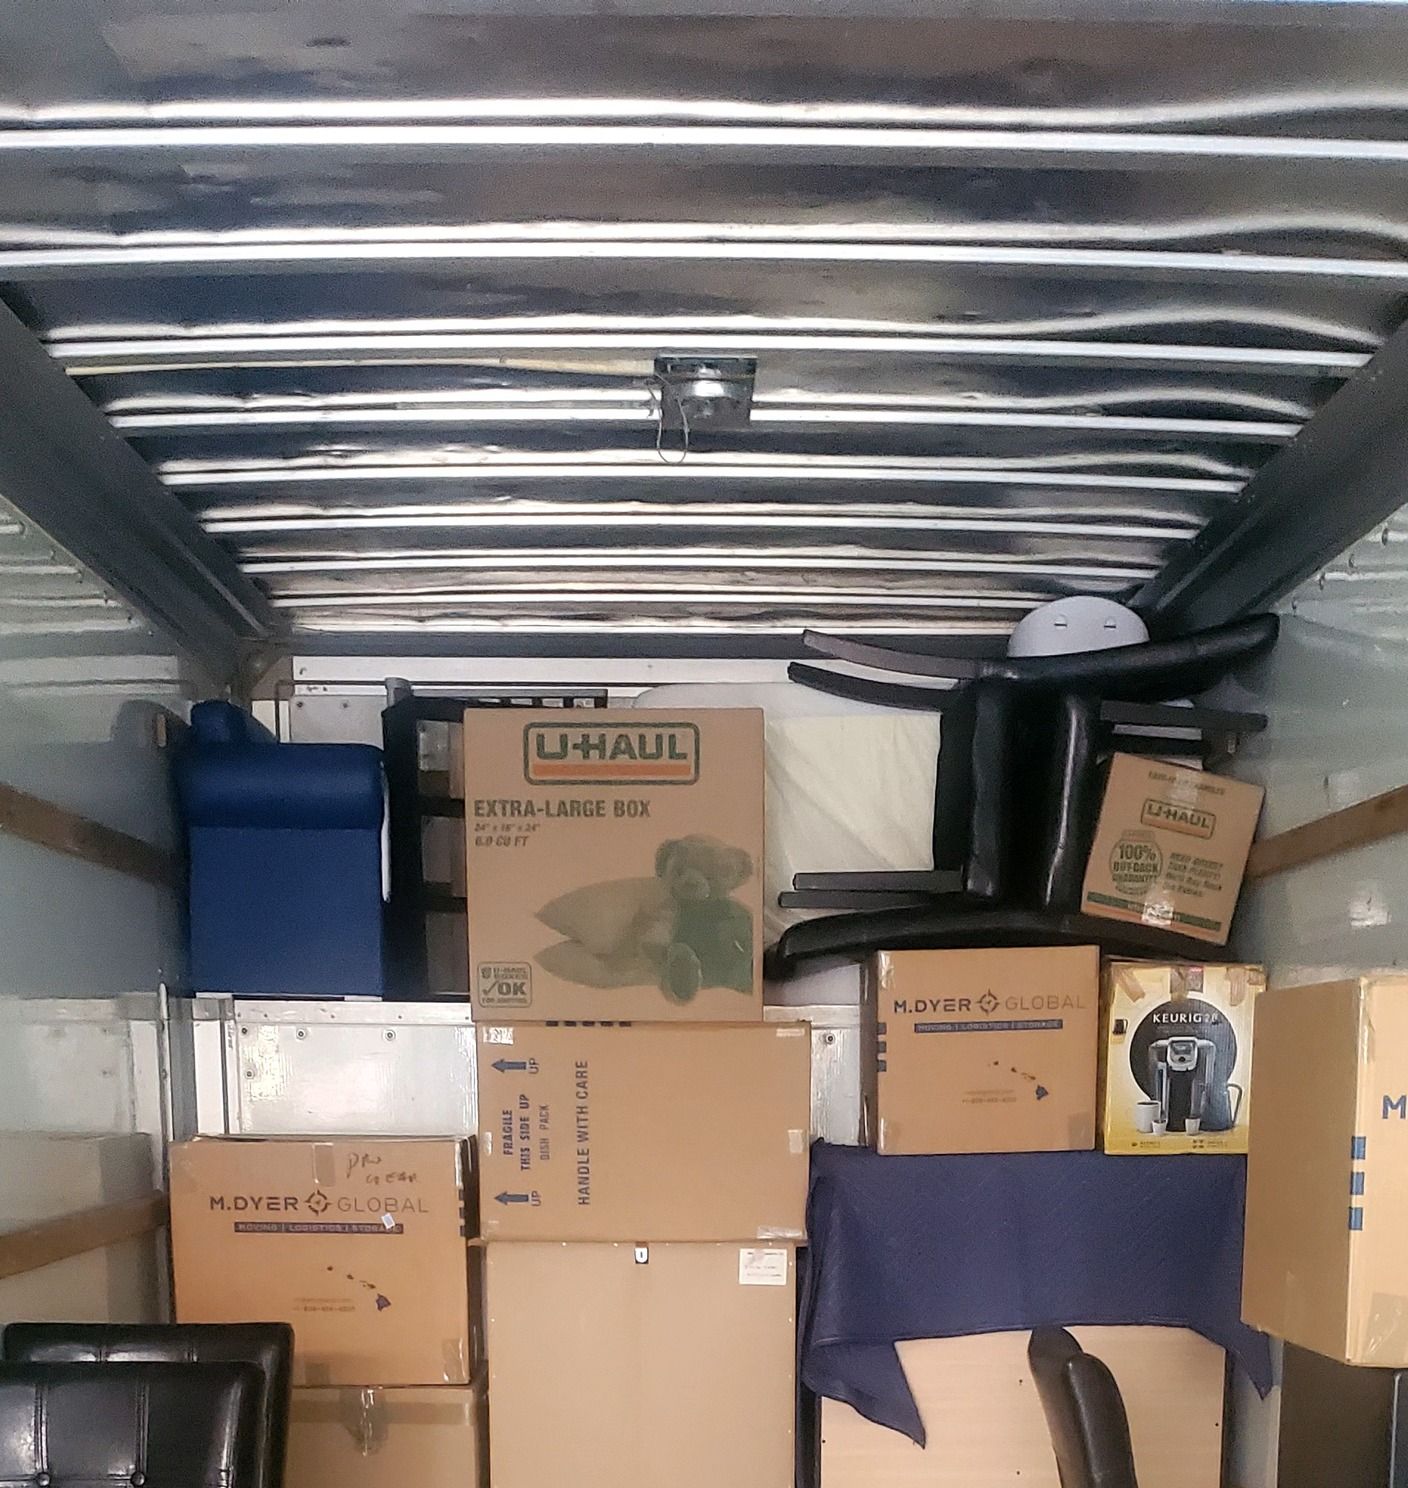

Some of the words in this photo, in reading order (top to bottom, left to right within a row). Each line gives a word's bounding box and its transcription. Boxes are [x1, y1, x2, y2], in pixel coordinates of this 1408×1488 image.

[535, 733, 689, 761] U-HAUL
[474, 799, 605, 818] EXTRA-LARGE
[613, 799, 651, 818] BOX
[1147, 803, 1209, 828] U-HAUL
[514, 835, 529, 847] FT
[1119, 843, 1156, 861] 100%
[498, 982, 527, 996] OK
[894, 998, 972, 1014] M.DYER
[1005, 994, 1087, 1011] GLOBAL
[1153, 1013, 1202, 1023] KEURIG
[528, 1057, 540, 1075] UP
[575, 1060, 588, 1100] CARE
[519, 1094, 530, 1109] UP
[520, 1116, 530, 1140] SIDE
[539, 1105, 549, 1130] PACK
[576, 1106, 589, 1143] WITH
[502, 1109, 513, 1155] FRAGILE
[520, 1147, 530, 1171] THIS
[540, 1138, 550, 1160] DISH
[577, 1148, 590, 1205] HANDLE
[209, 1196, 299, 1212] M.DYER
[337, 1197, 430, 1213] GLOBAL
[531, 1190, 542, 1207] UP
